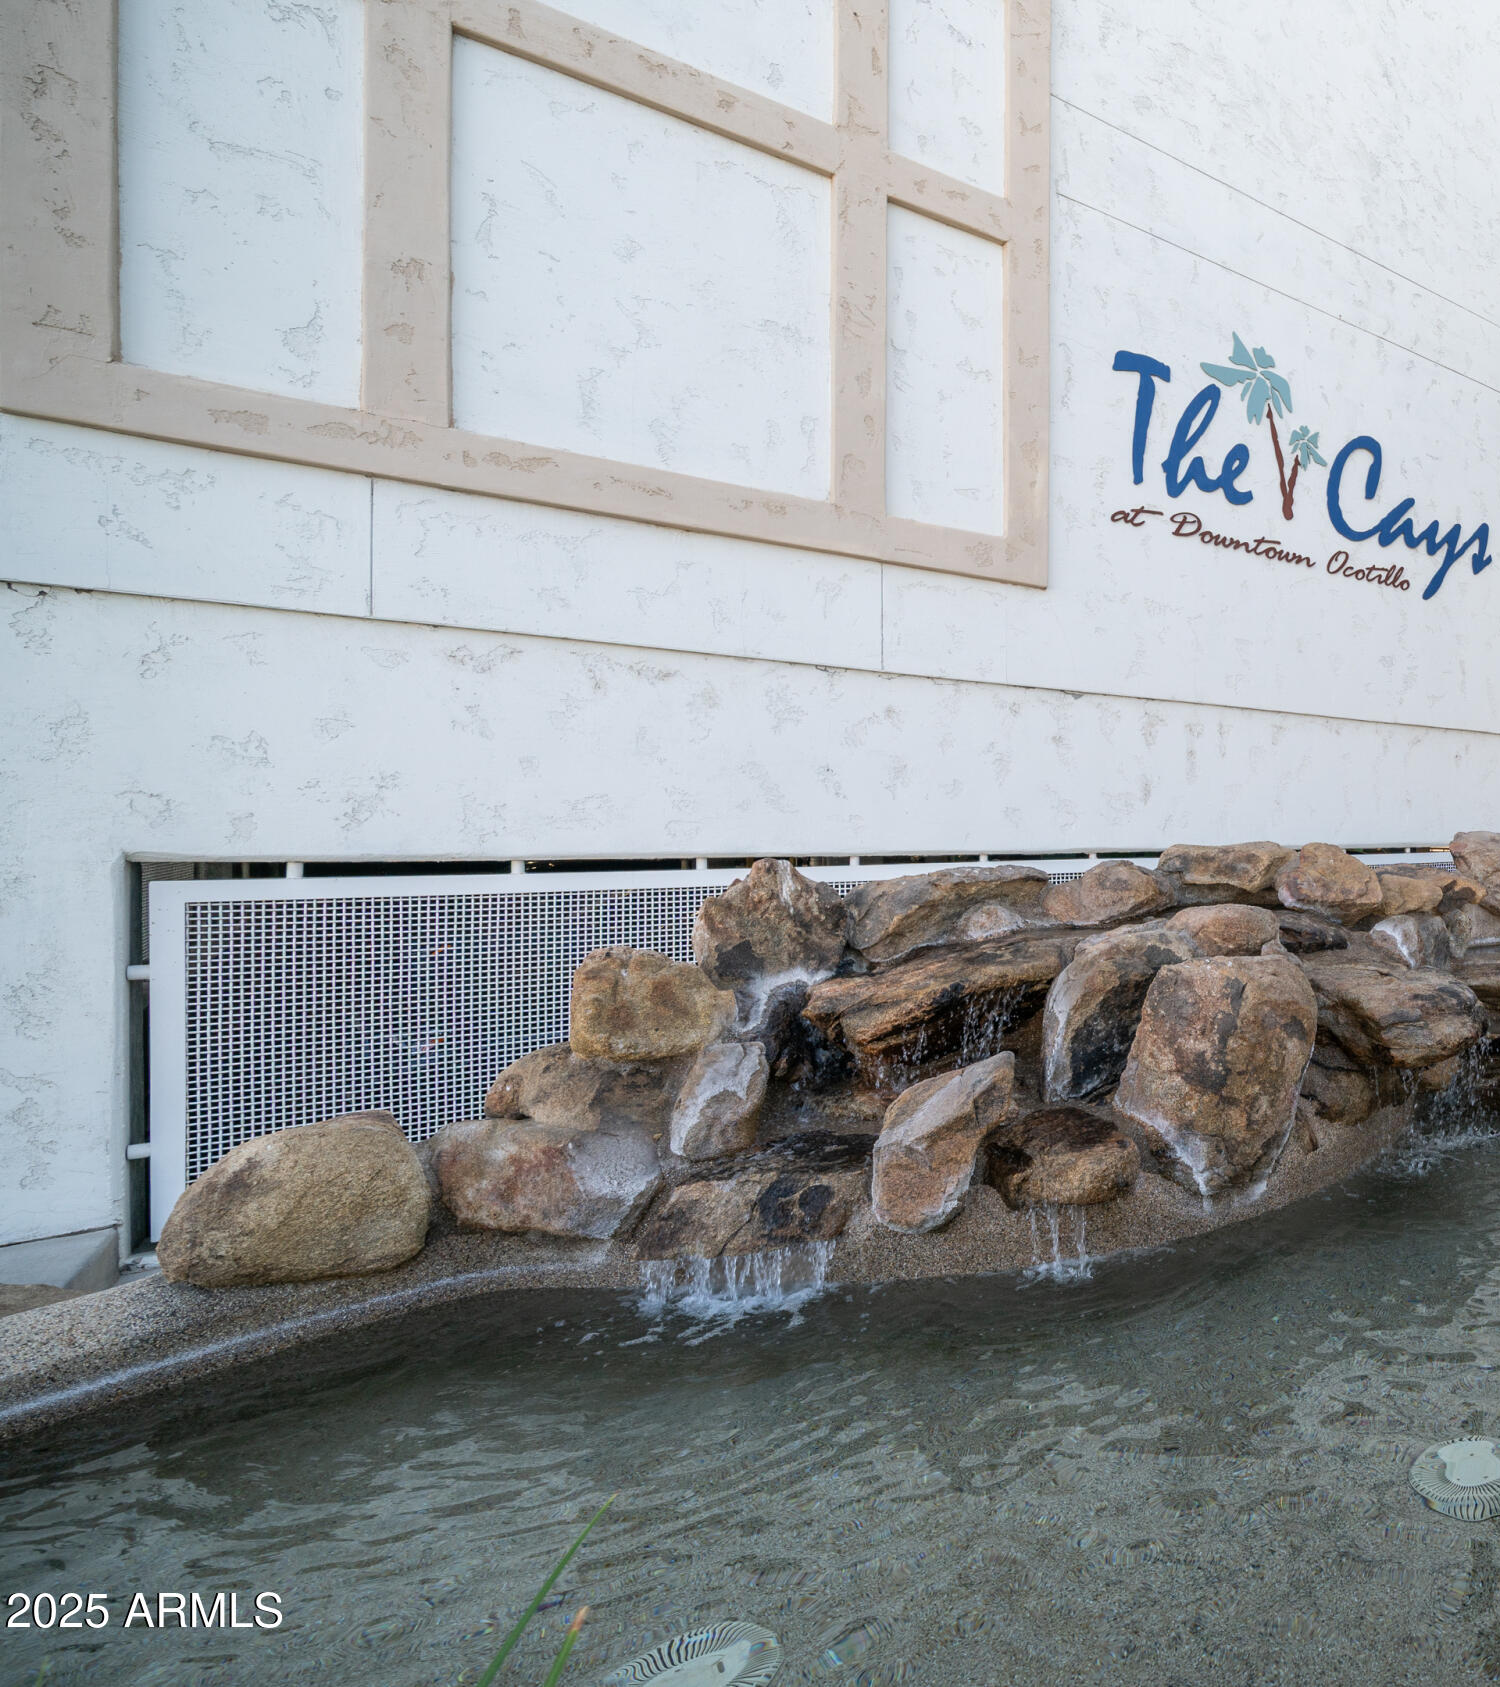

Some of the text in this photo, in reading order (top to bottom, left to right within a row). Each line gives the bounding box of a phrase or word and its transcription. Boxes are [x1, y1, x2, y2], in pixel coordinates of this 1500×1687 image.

[1110, 505, 1411, 592] at Downtown Ocotillo
[1112, 350, 1492, 600] The Cays
